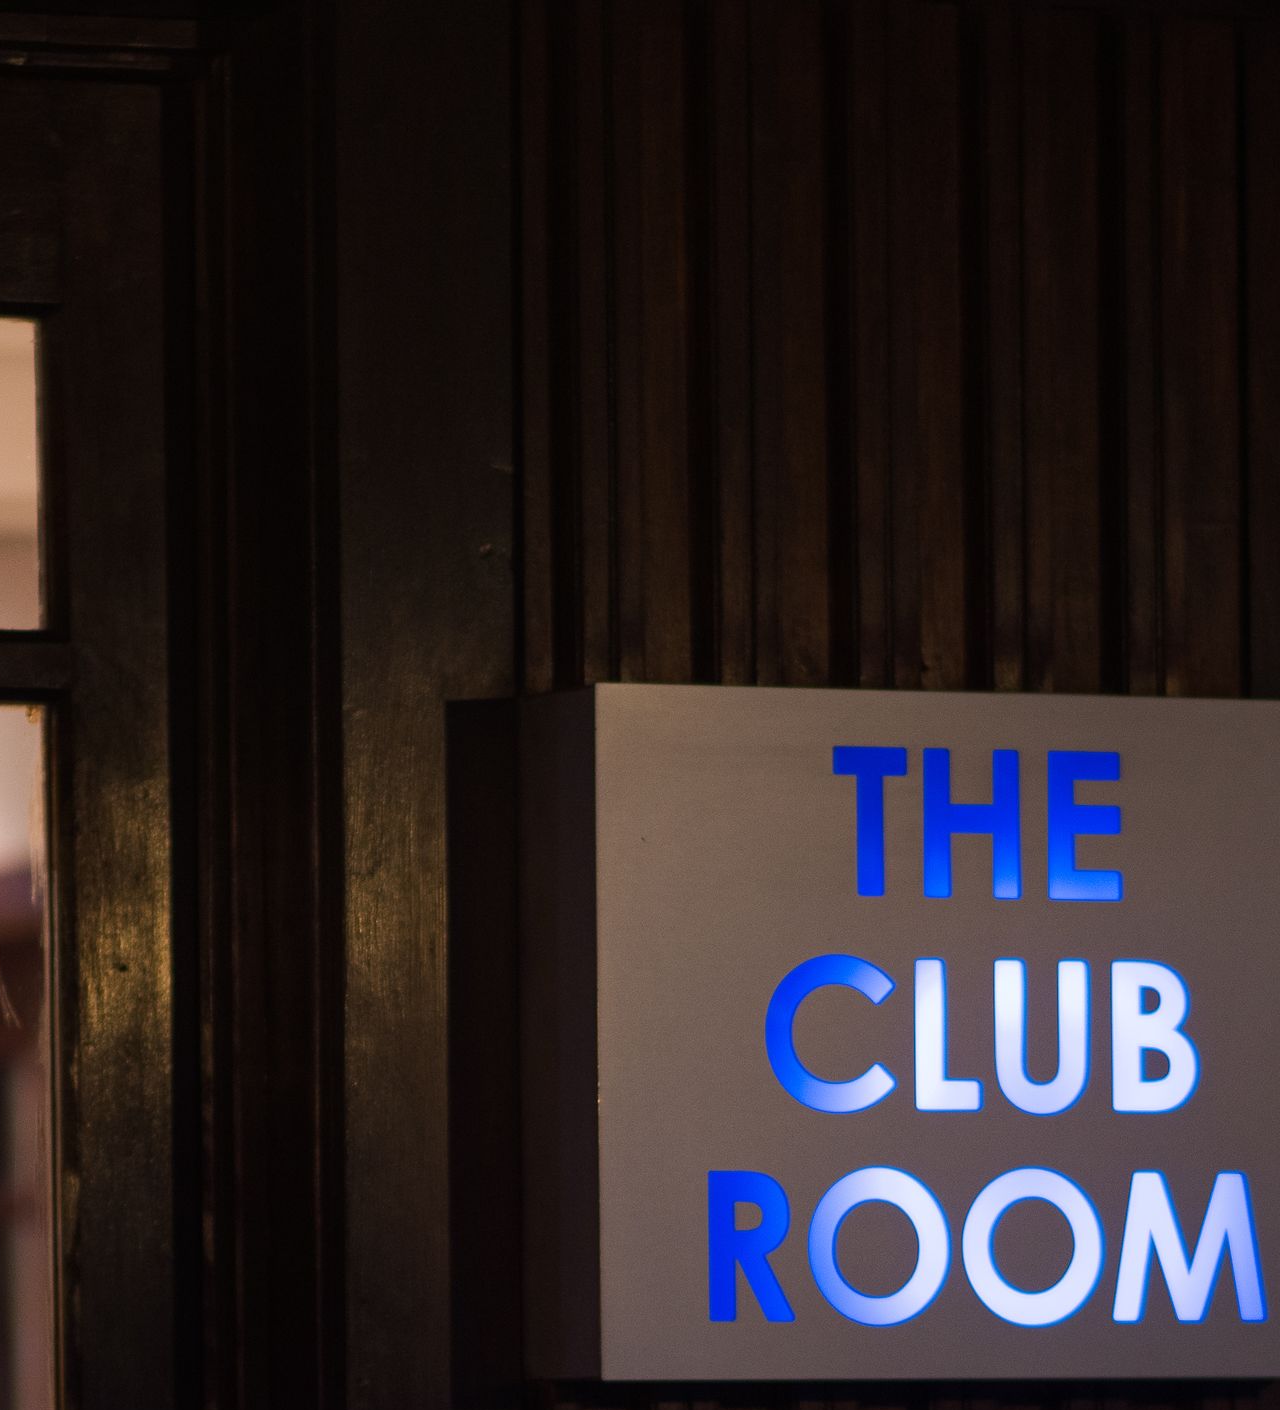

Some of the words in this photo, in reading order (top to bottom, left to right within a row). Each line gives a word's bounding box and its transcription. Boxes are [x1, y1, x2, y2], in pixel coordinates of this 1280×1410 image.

[832, 746, 1123, 902] THE
[765, 953, 1201, 1117] CLUB
[707, 1166, 1268, 1328] ROOM
